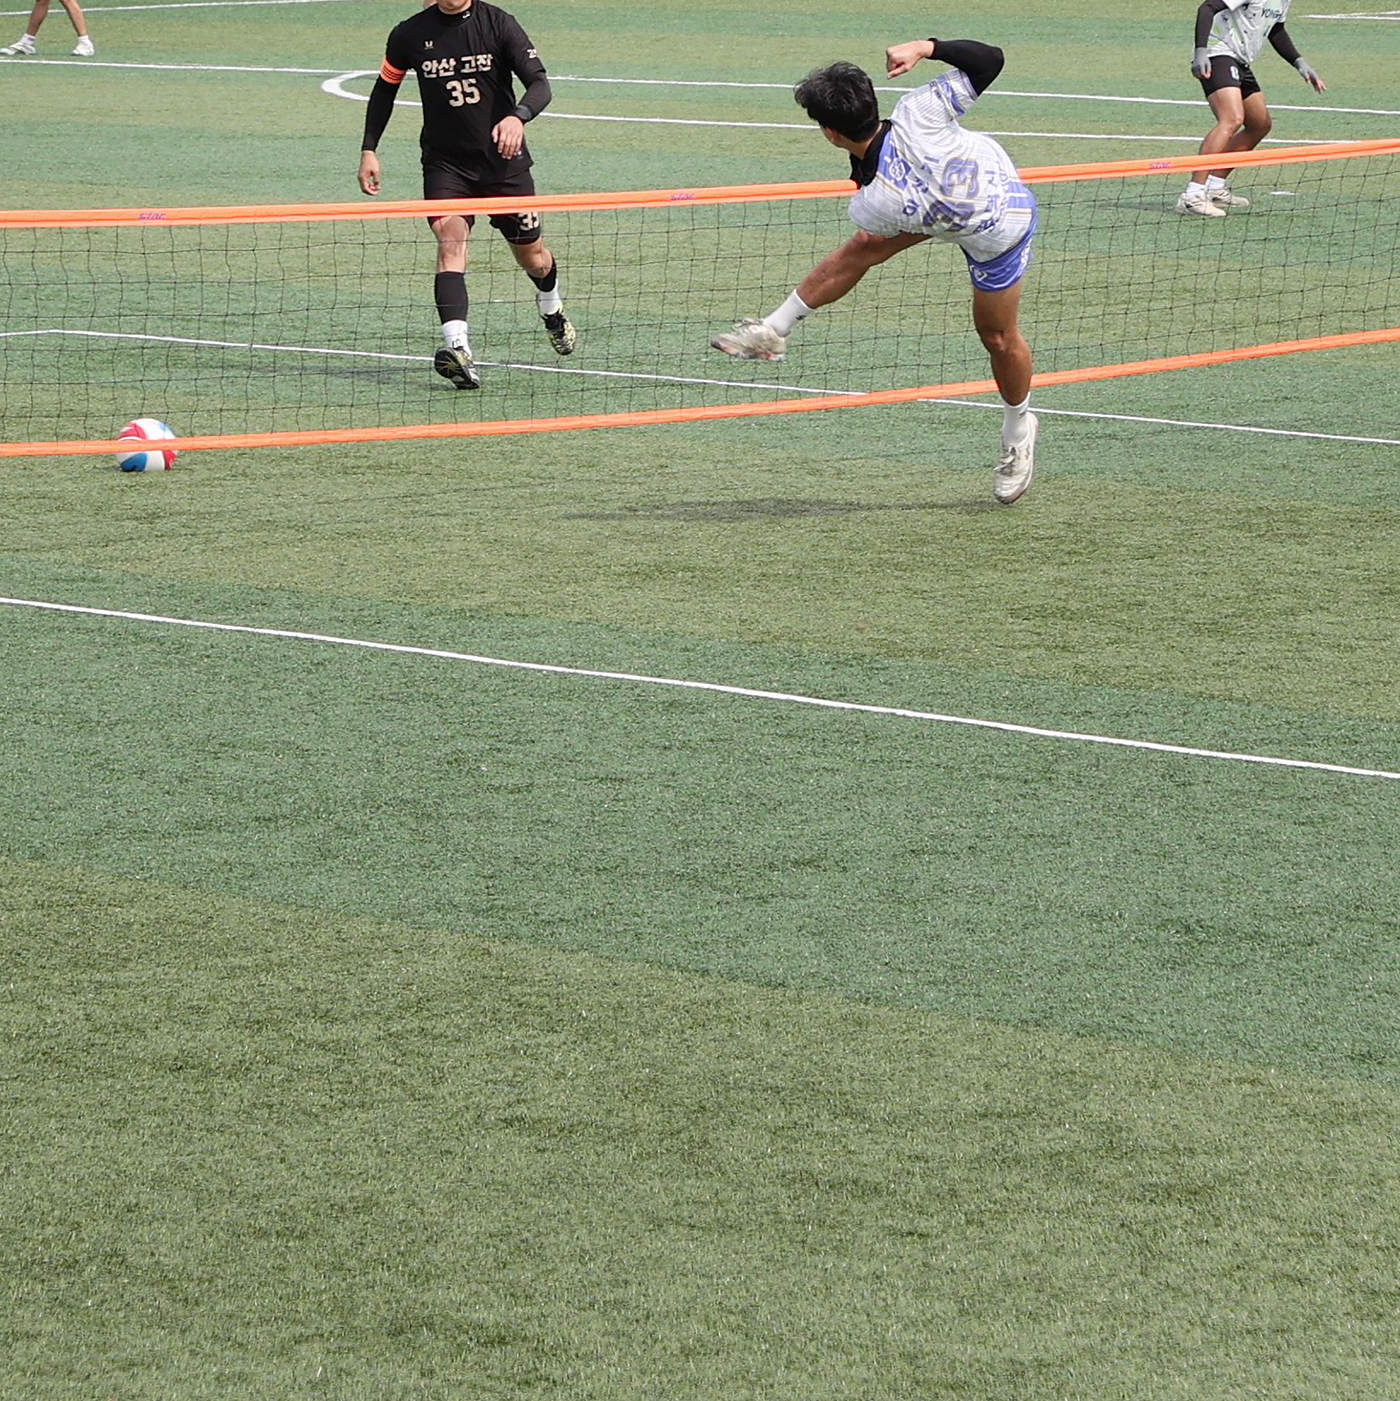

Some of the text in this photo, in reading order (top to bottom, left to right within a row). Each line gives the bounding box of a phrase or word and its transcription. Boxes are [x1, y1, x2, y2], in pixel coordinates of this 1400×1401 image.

[421, 53, 494, 78] 안산 고잔
[446, 79, 481, 108] 35
